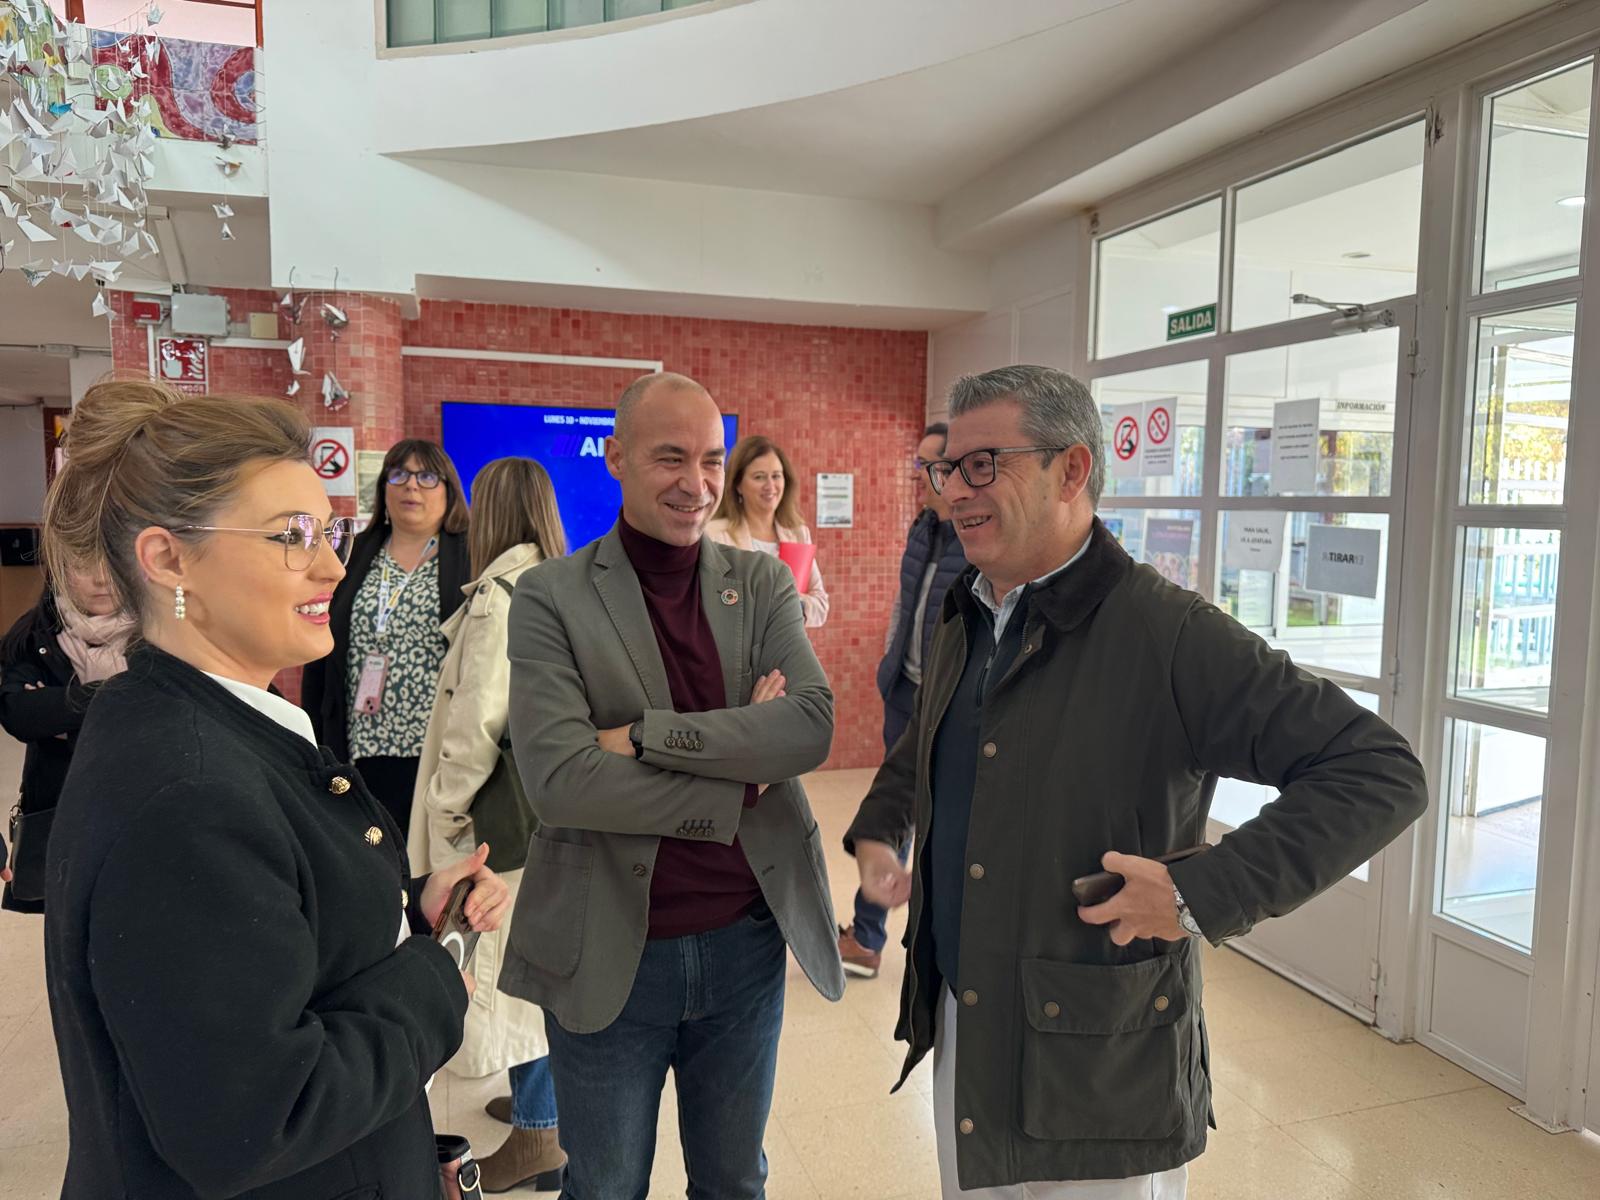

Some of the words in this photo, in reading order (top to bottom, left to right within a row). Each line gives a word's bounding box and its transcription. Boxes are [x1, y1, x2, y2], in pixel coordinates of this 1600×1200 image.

[1170, 310, 1212, 335] SALIDA
[543, 415, 565, 424] LUNES
[1329, 551, 1355, 565] TIRAR
